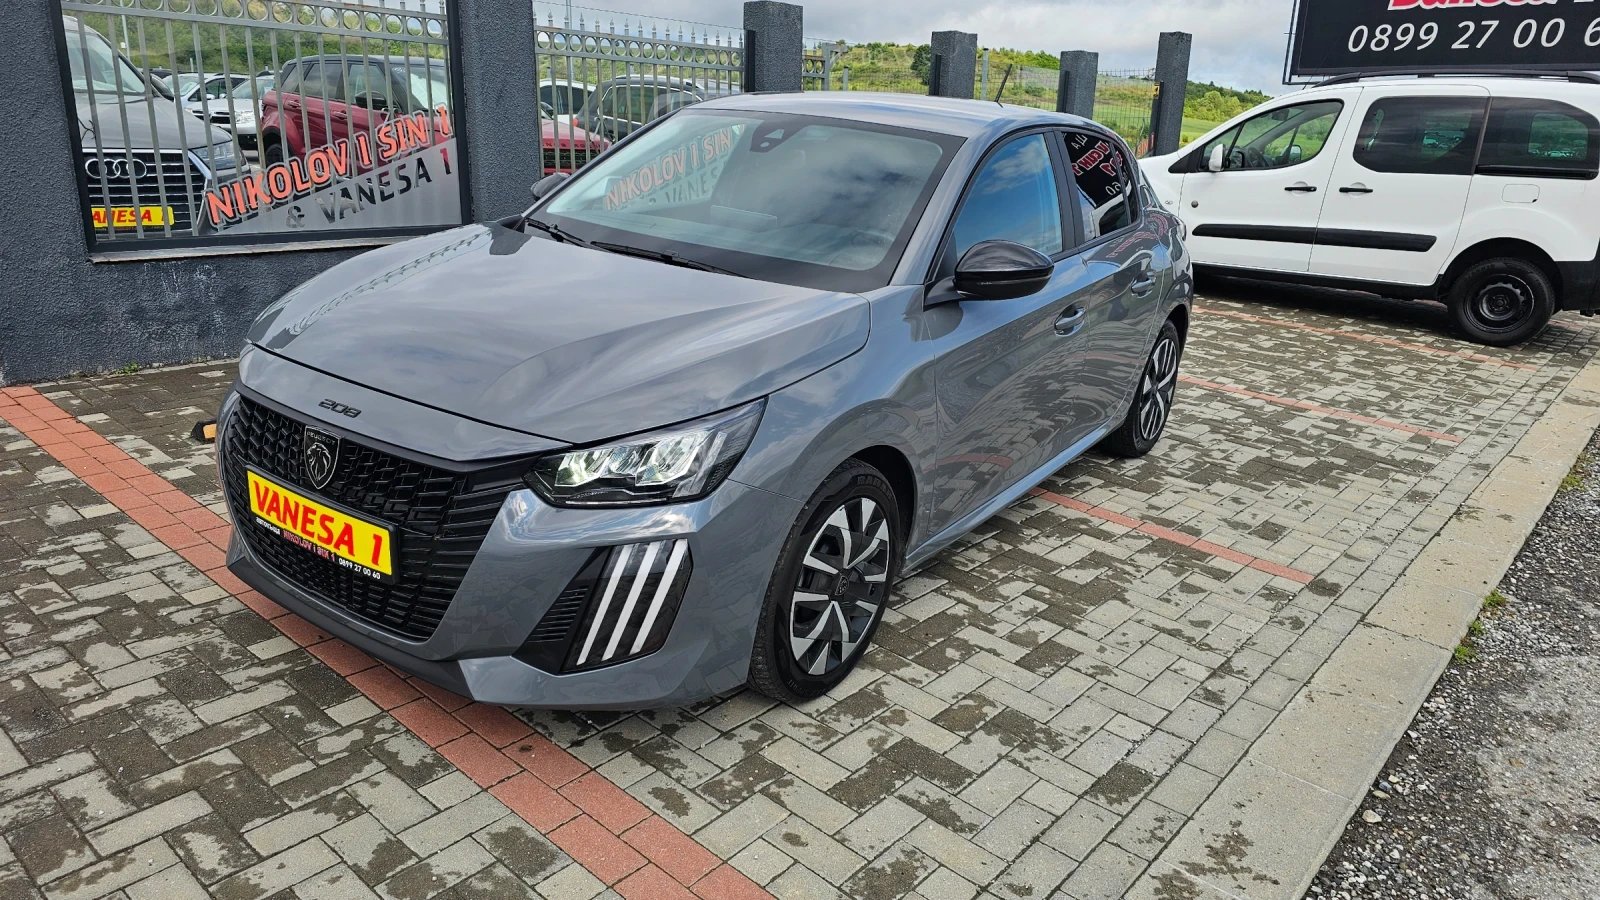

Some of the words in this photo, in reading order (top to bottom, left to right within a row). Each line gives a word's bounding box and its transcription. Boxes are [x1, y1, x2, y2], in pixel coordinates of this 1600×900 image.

[1348, 22, 1439, 53] 0899
[1451, 20, 1500, 50] 27
[1513, 17, 1566, 48] 00
[204, 140, 350, 227] NIKOLOV
[355, 133, 373, 167] I
[377, 112, 429, 160] SIN
[436, 104, 452, 136] 1
[286, 205, 306, 228] &
[315, 156, 433, 224] VANESA
[439, 147, 452, 175] 1
[605, 146, 686, 211] NIKOLOV
[702, 127, 733, 161] SIN
[318, 398, 362, 418] 208
[254, 480, 355, 557] VANESA
[371, 534, 383, 567] 1
